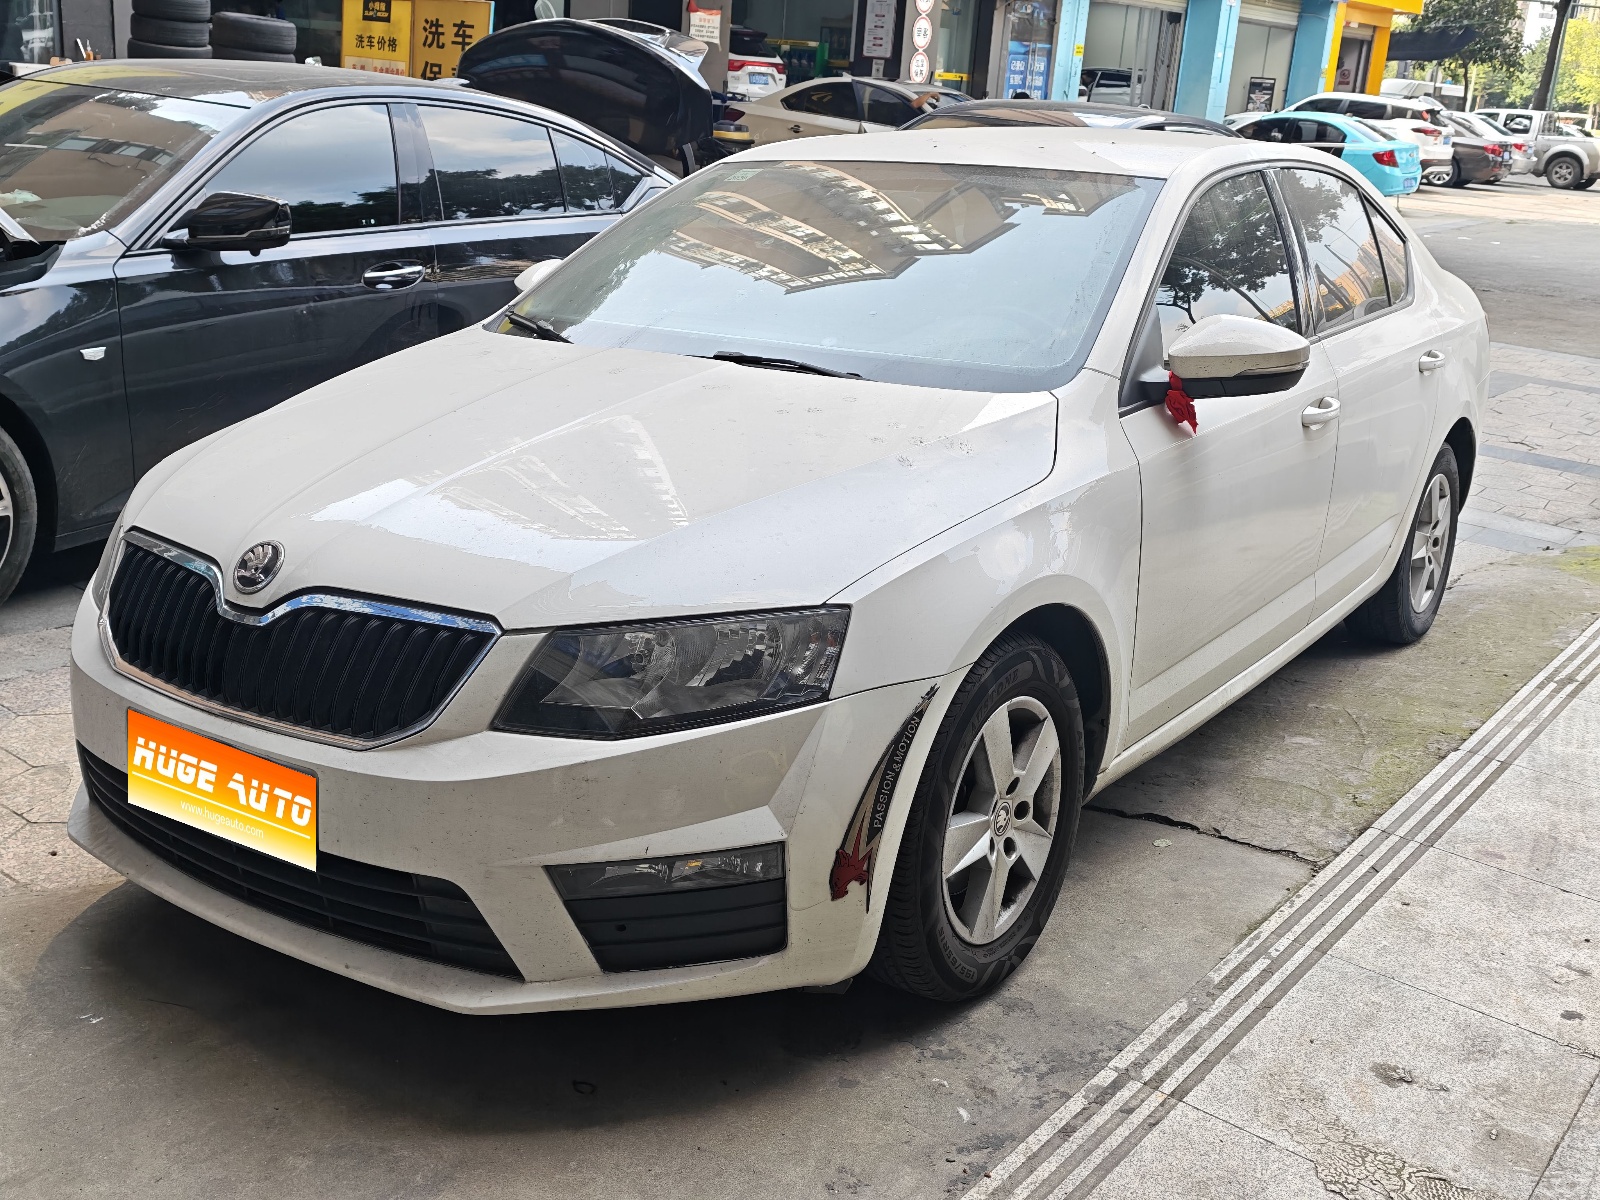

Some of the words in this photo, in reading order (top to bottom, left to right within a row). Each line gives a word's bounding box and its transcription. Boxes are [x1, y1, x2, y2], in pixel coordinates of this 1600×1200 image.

[355, 34, 398, 53] 洗车价格
[422, 18, 475, 52] 洗车
[873, 771, 896, 828] PASSION
[894, 716, 921, 761] MOTION
